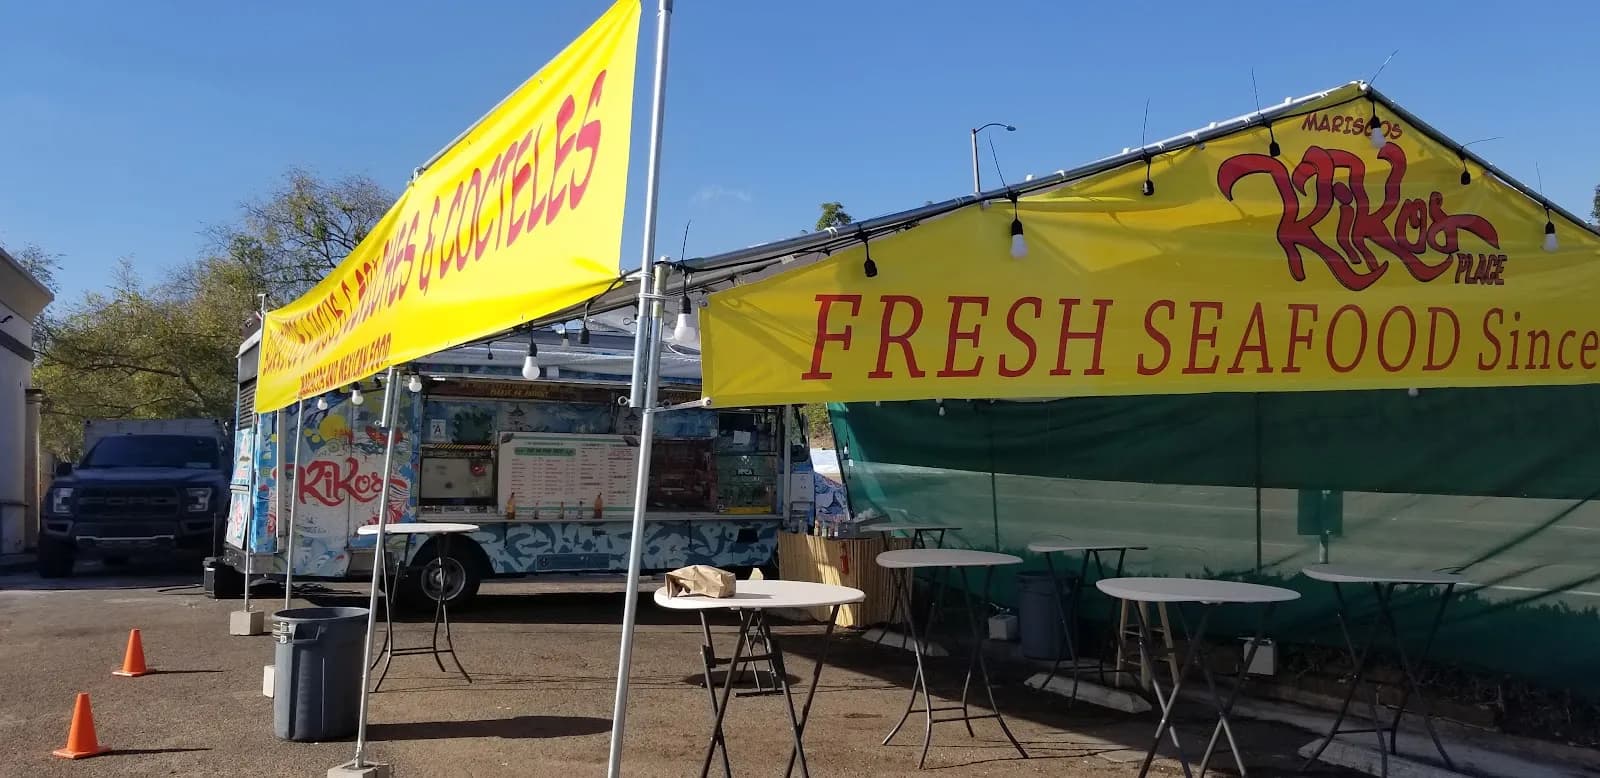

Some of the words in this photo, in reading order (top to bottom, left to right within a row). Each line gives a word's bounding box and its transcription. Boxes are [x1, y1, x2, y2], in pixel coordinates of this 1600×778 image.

[418, 196, 440, 297] &
[439, 69, 607, 281] COCTELES
[1454, 253, 1508, 285] PLACE
[325, 359, 339, 388] AND
[338, 343, 371, 381] MEXICAN
[367, 332, 392, 371] FOOD
[802, 293, 1114, 381] FRESH
[1137, 299, 1461, 376] SEAFOOD
[1477, 306, 1599, 371] Since
